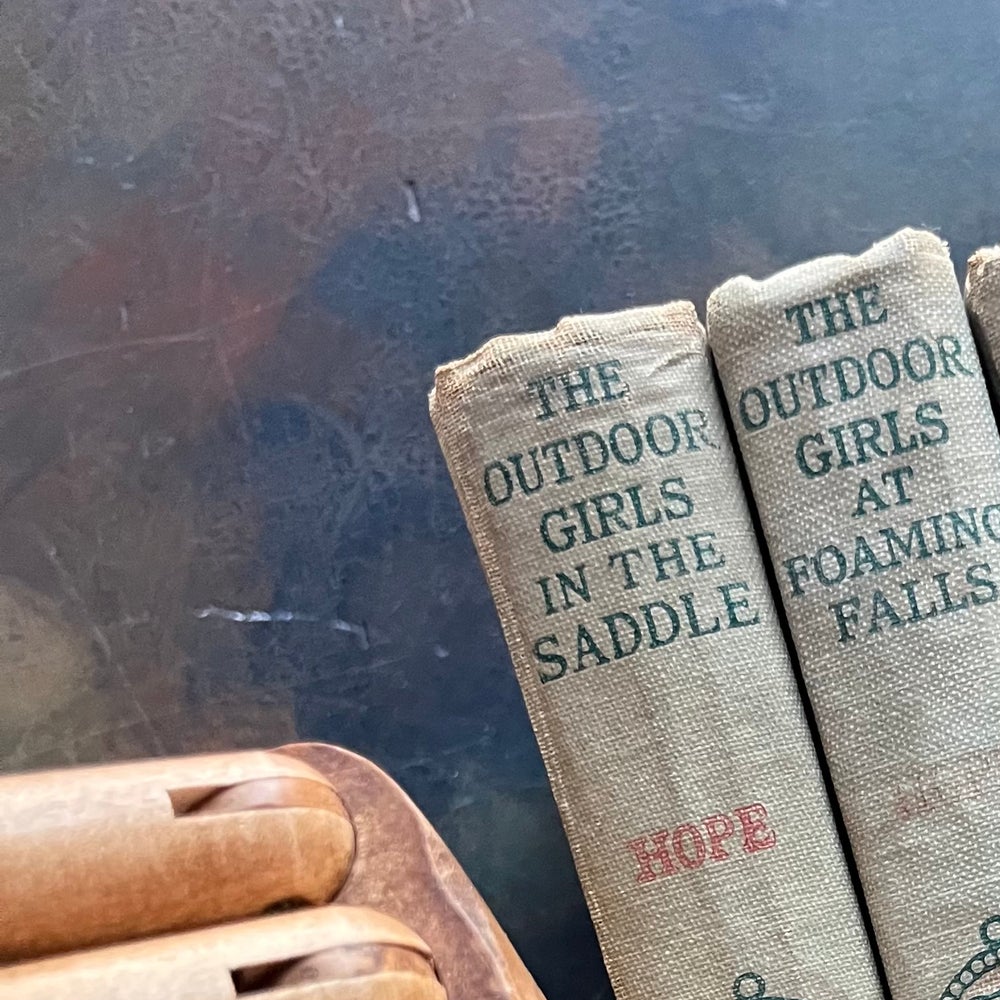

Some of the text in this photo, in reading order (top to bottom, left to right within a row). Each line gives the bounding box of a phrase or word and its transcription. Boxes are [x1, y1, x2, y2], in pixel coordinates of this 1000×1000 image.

[785, 283, 888, 345] THE
[528, 359, 630, 421] THE
[739, 335, 974, 431] OUTDOOR
[483, 409, 720, 506] OUTDOOR
[795, 402, 949, 479] GIRLS
[540, 477, 694, 553] GIRLS
[852, 466, 913, 517] AT
[535, 532, 725, 615] IN THE
[828, 562, 999, 642] FALLS
[534, 582, 760, 684] SADDLE
[627, 802, 777, 885] HOPE
